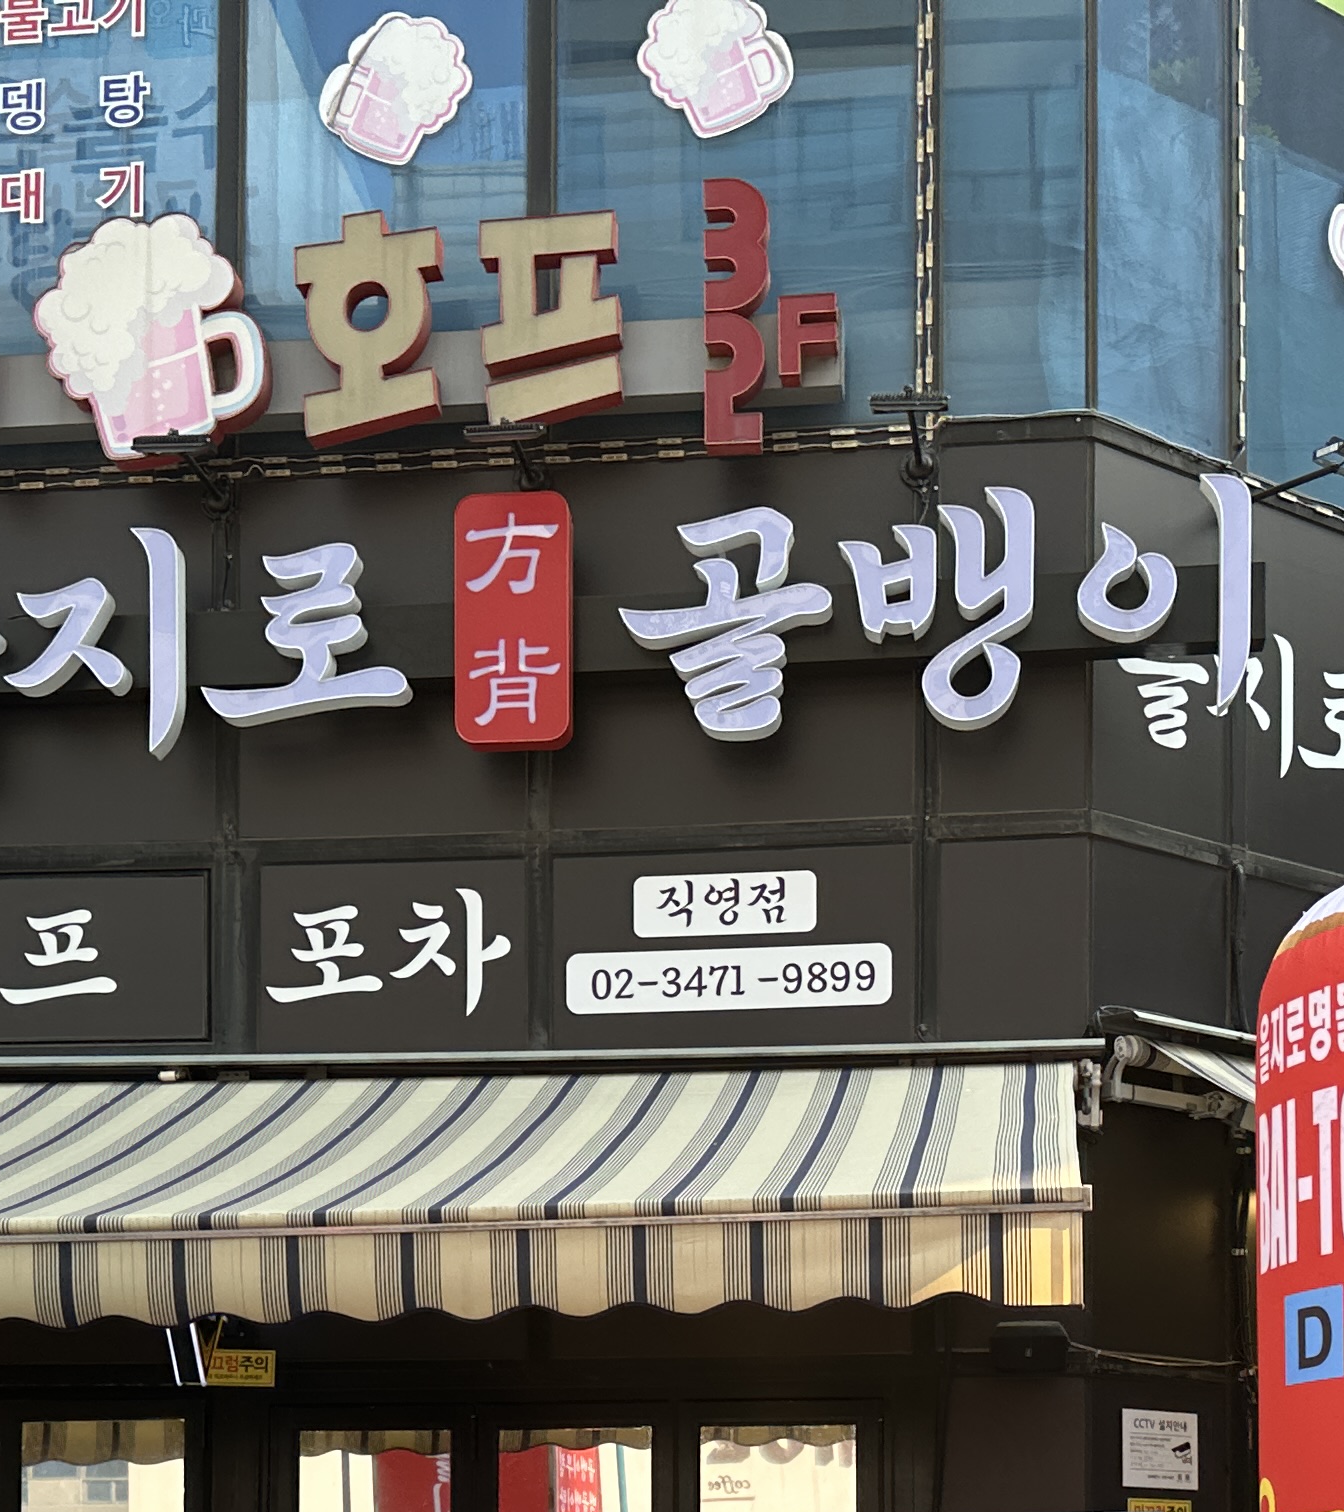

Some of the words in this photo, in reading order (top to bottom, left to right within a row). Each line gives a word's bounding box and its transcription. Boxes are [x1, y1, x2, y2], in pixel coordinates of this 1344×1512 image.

[294, 209, 624, 450] 호프
[465, 511, 562, 727] 方背
[617, 472, 1253, 742] 골뱅이
[265, 886, 511, 1018] 포차
[654, 875, 789, 929] 직영점
[589, 959, 878, 1003] 02-3471-9899
[1133, 1418, 1156, 1430] CCTV
